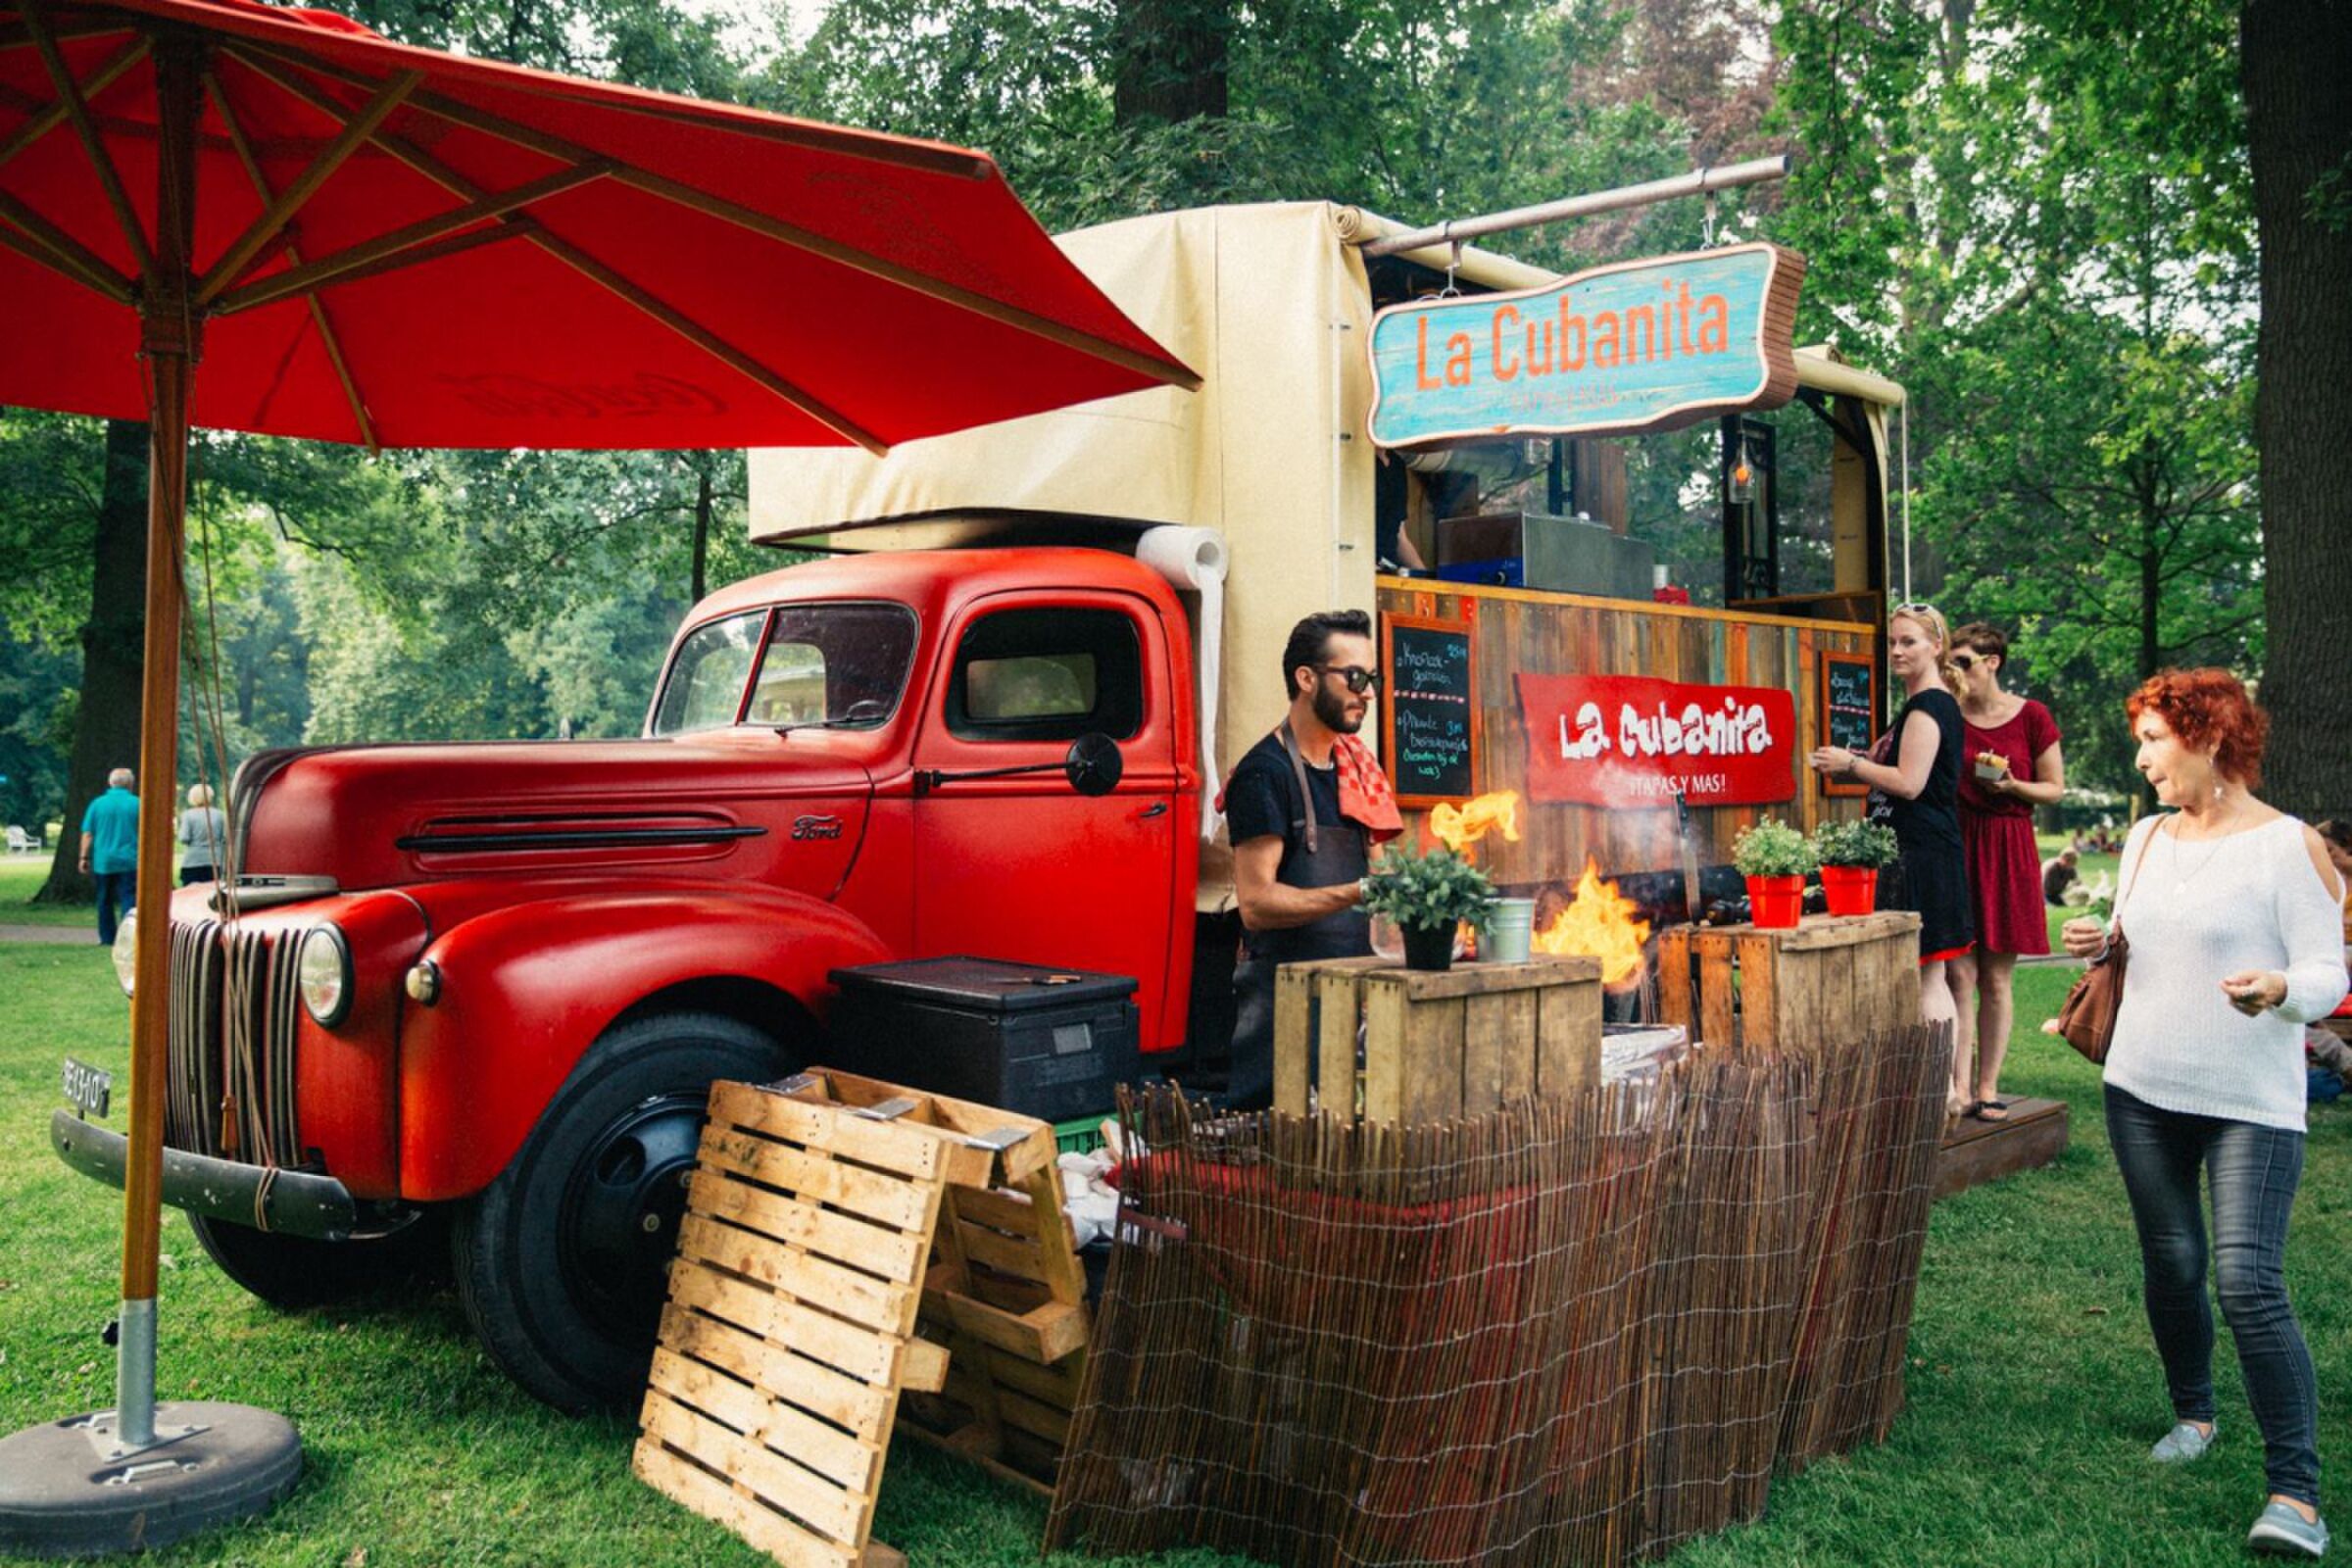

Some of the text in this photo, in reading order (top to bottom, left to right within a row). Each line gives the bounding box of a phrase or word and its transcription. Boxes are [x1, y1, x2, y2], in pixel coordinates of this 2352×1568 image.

[1415, 278, 1730, 391] La Cubanita
[1559, 695, 1774, 760] La Cubanita
[1680, 774, 1690, 795] Y
[1692, 773, 1726, 795] MAS!
[792, 814, 844, 840] Ford
